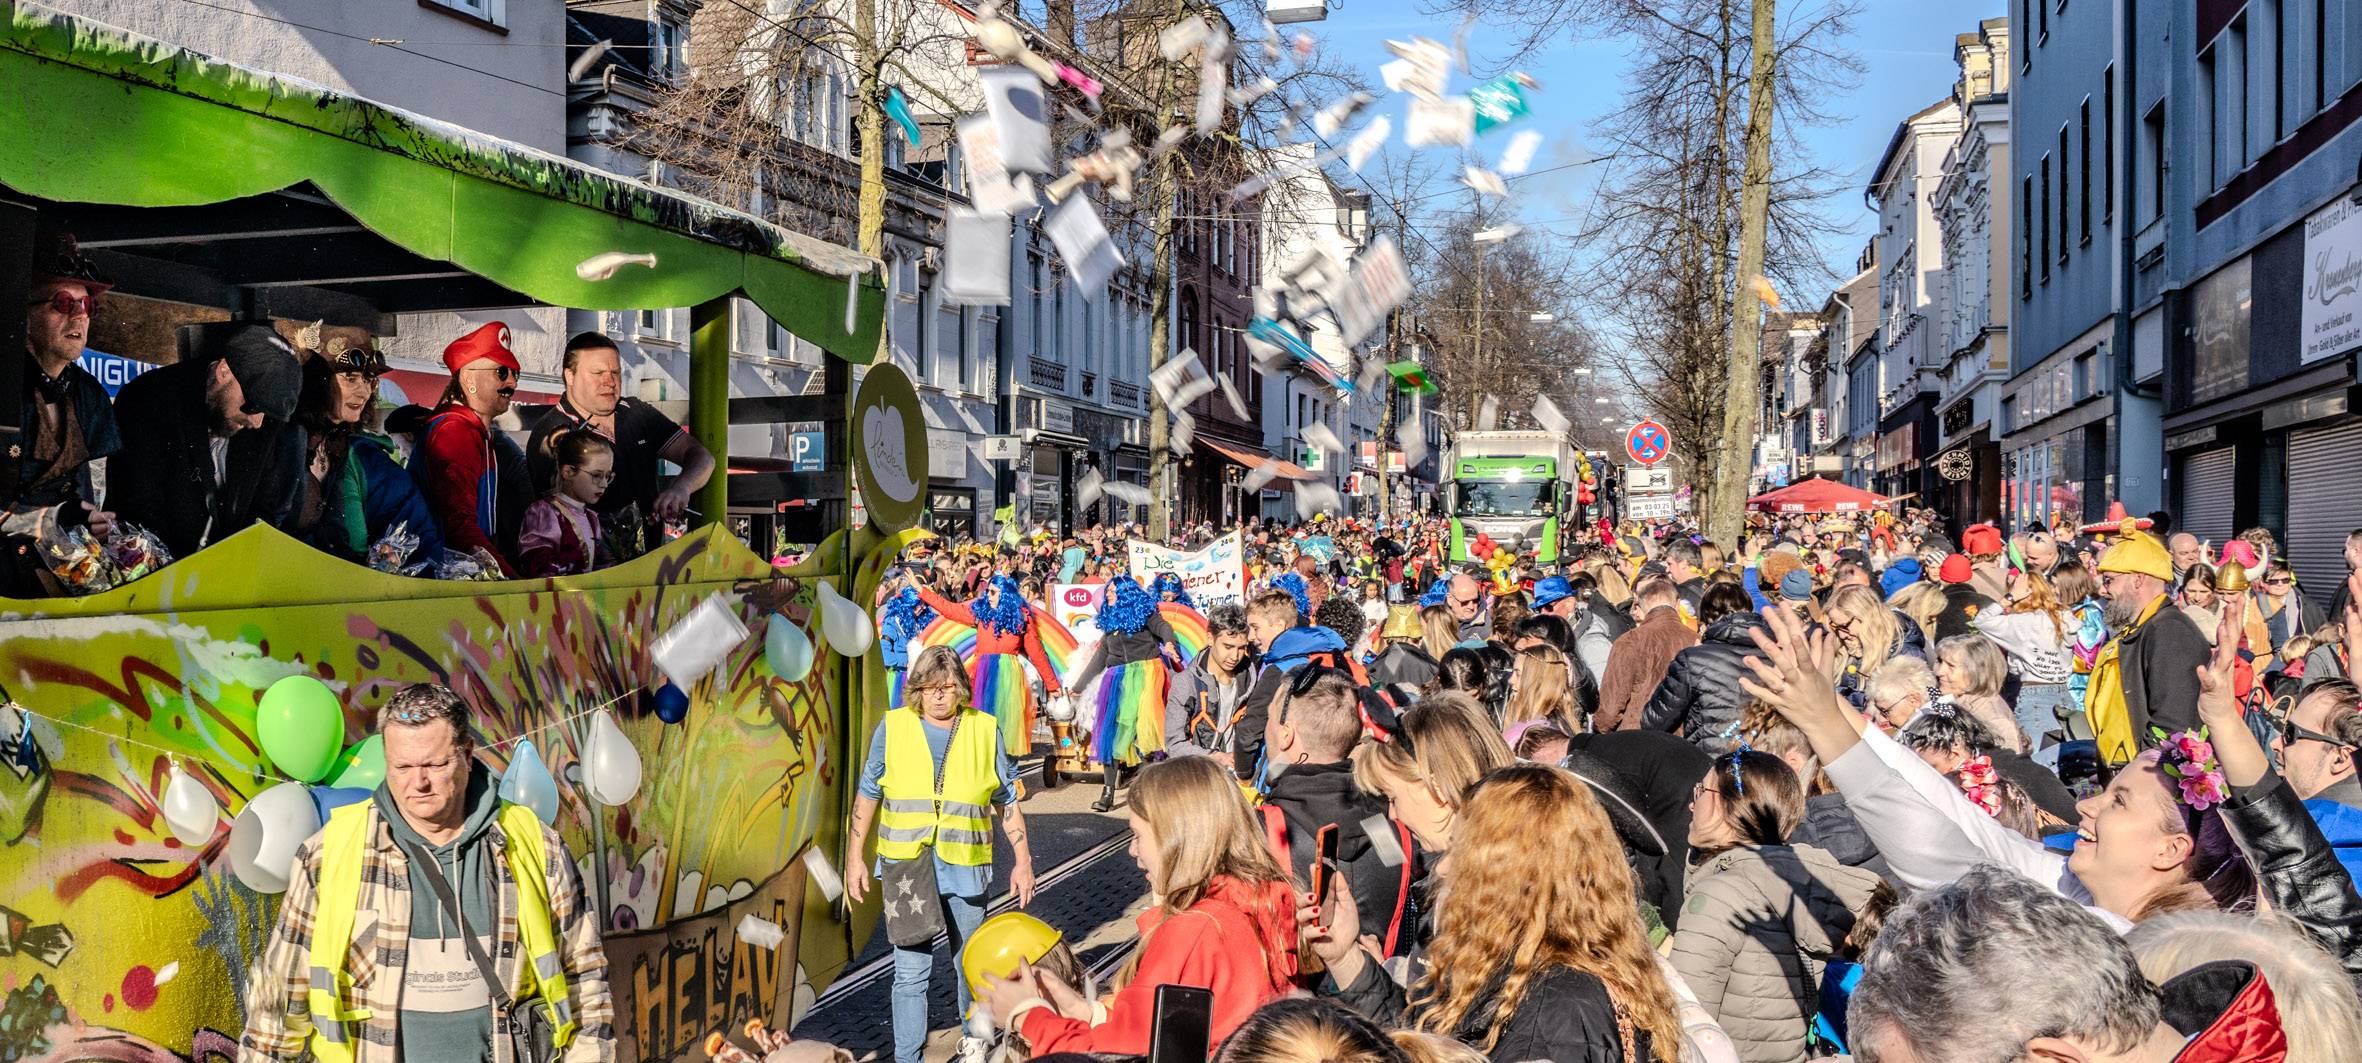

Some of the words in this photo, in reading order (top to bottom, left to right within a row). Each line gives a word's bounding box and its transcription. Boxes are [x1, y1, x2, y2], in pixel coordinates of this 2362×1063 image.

[796, 436, 810, 464] P
[1835, 502, 1859, 510] REWE
[1143, 555, 1175, 570] Die
[1069, 591, 1087, 602] kfd
